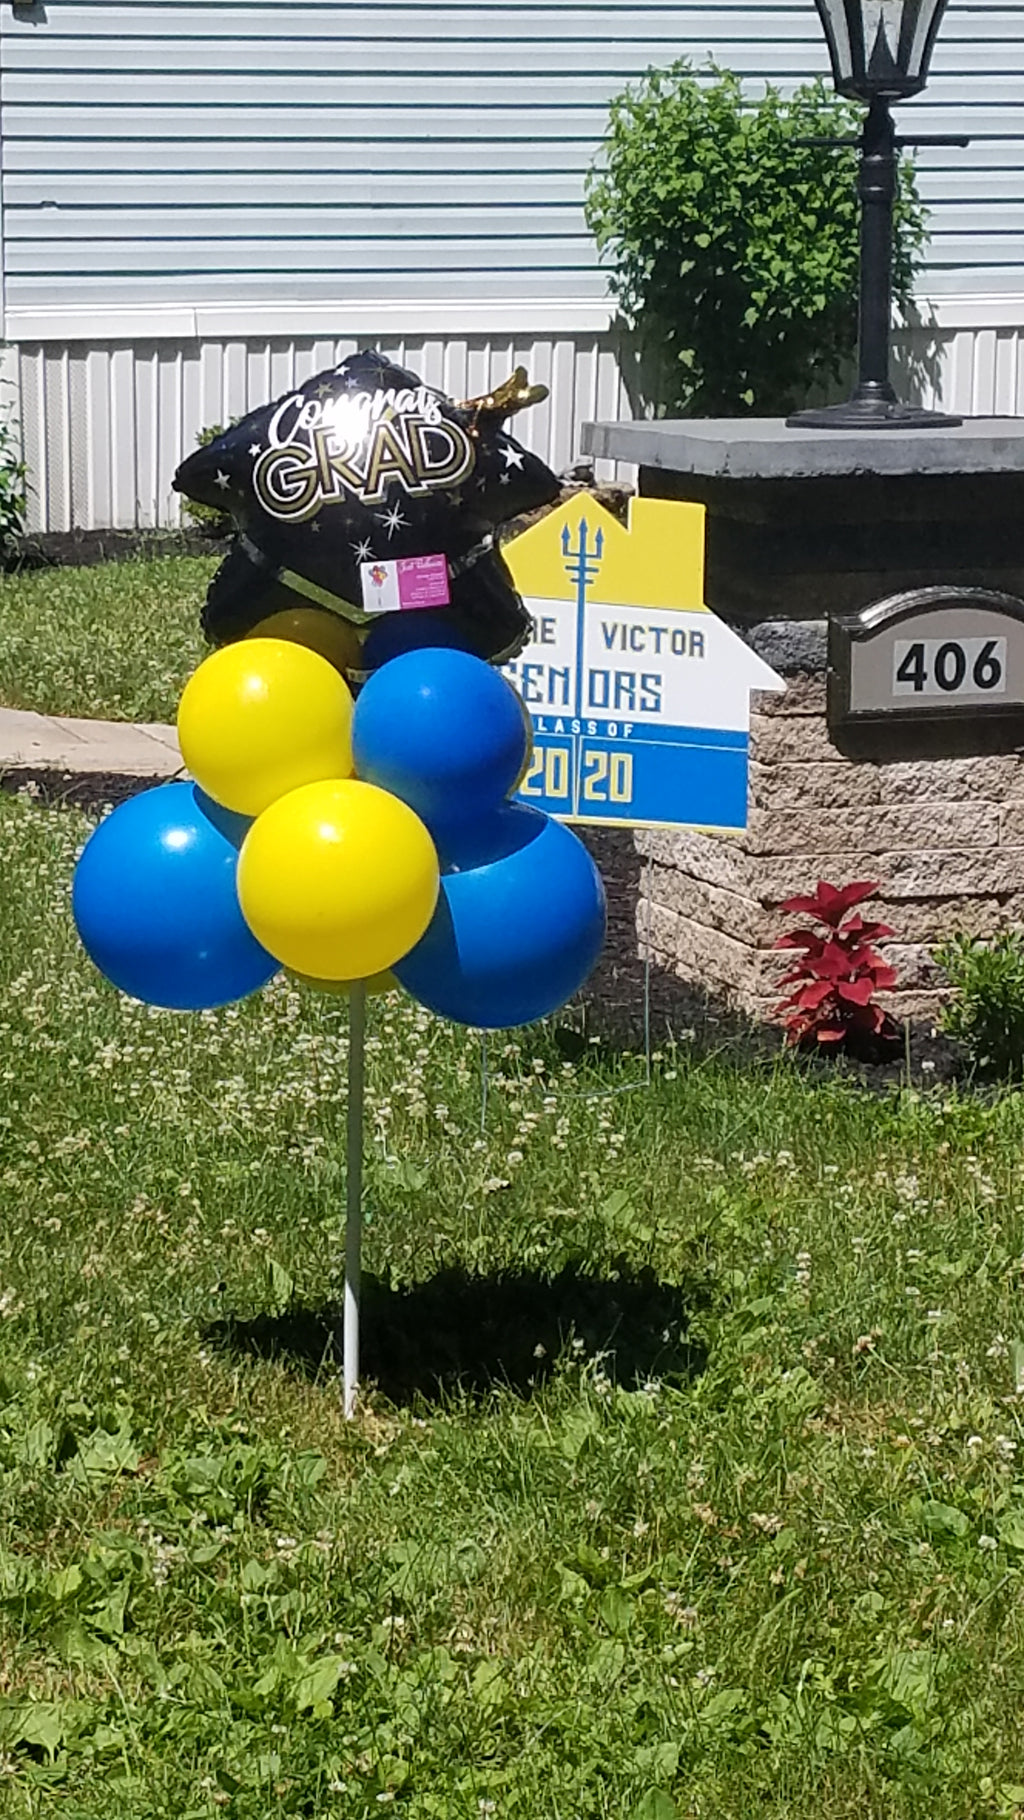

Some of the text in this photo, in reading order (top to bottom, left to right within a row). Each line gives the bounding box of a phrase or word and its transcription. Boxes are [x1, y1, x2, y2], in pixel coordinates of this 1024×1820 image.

[268, 386, 442, 449] Congrats
[253, 414, 477, 522] GRAD
[601, 621, 706, 659] VICTOR
[896, 640, 1002, 692] 406
[607, 722, 635, 738] OF
